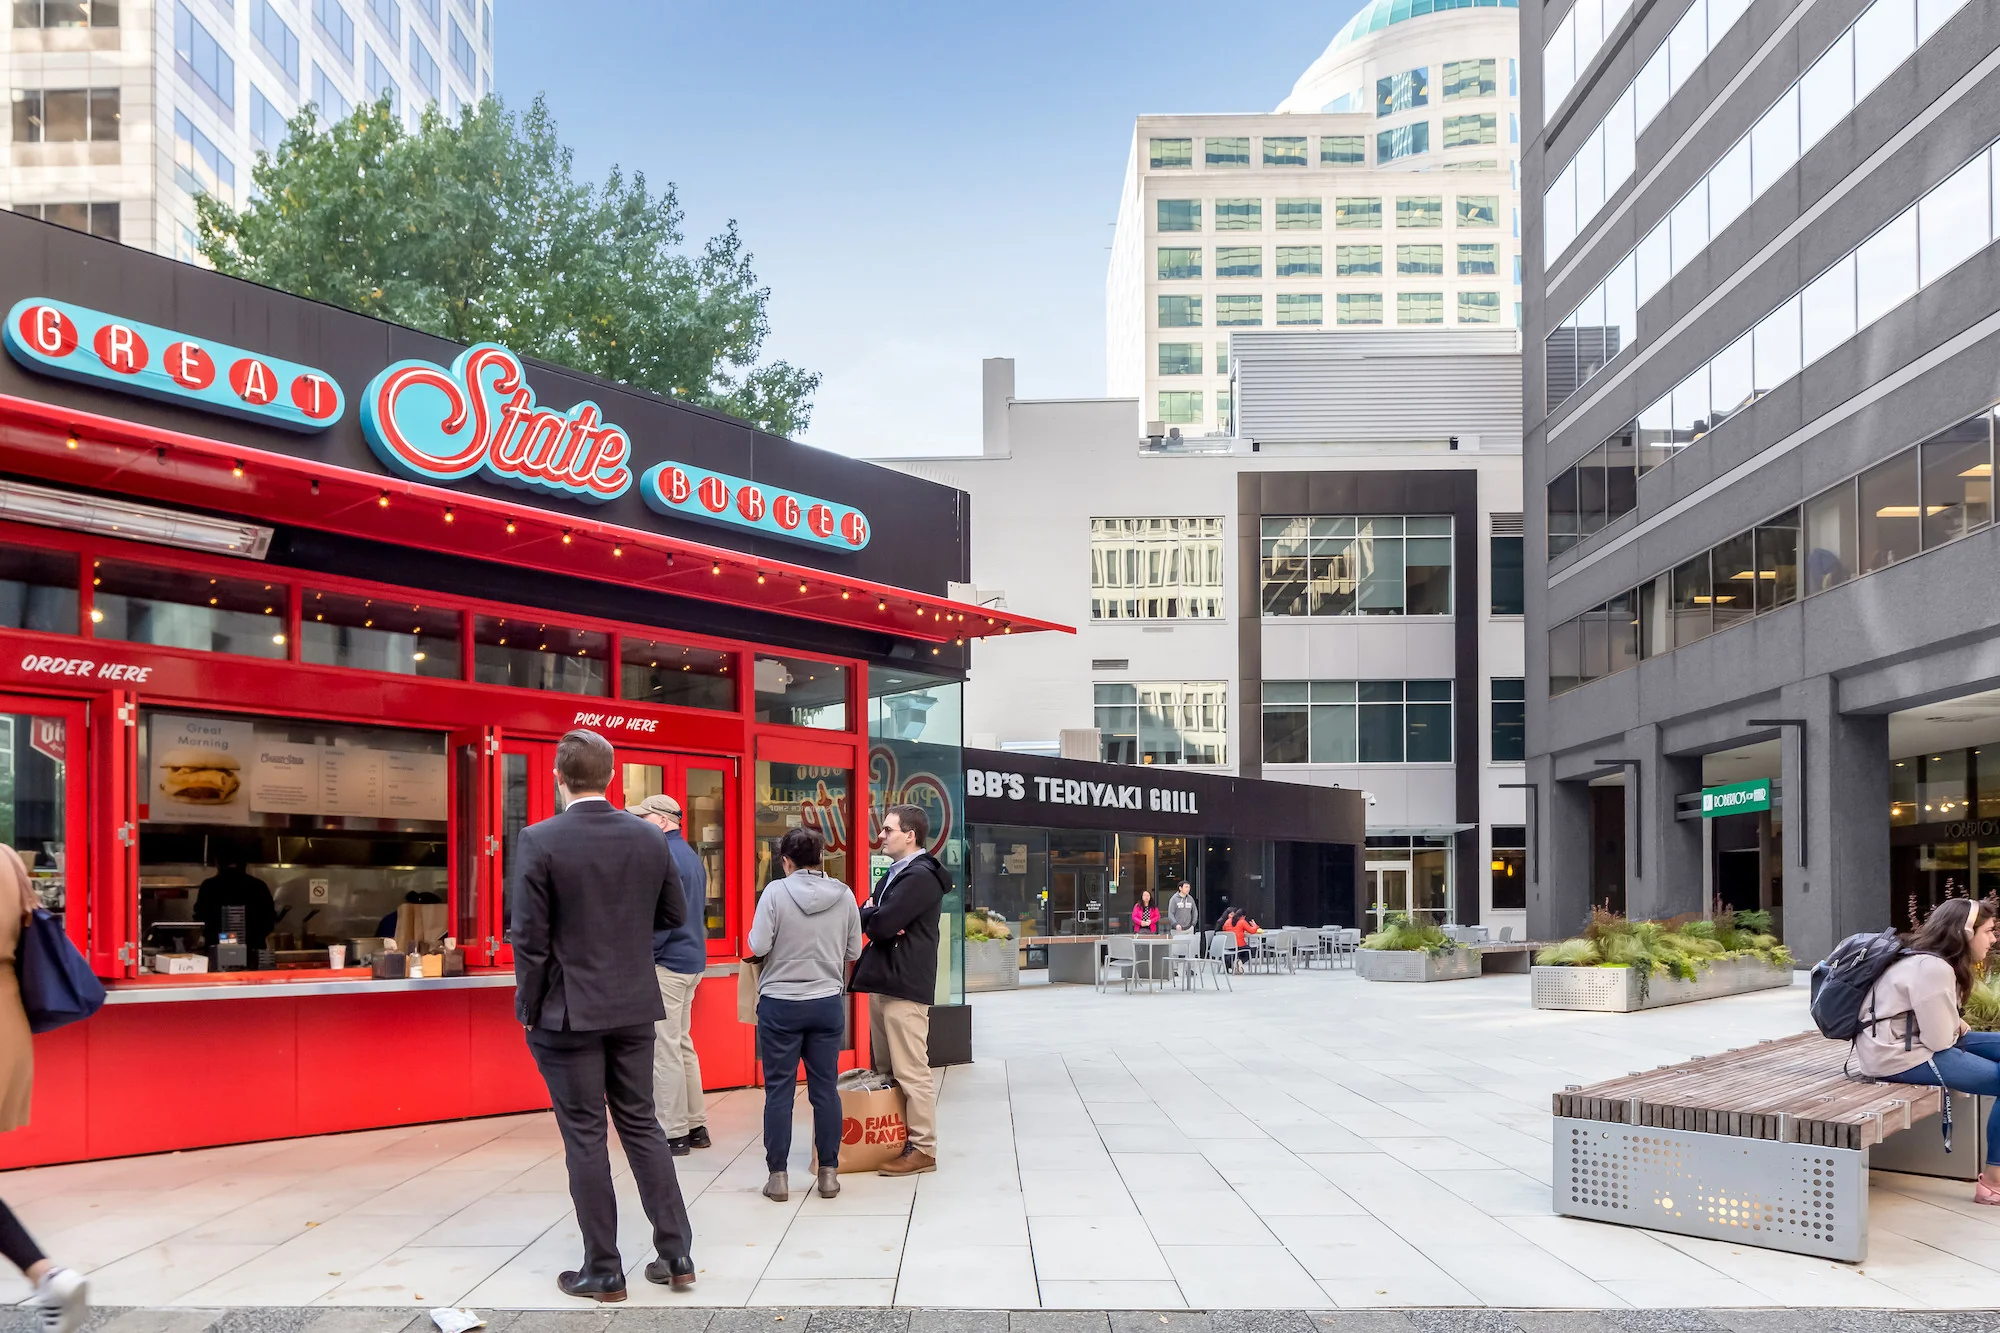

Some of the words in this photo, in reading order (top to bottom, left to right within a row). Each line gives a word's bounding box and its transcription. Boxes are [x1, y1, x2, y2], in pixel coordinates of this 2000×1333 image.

[36, 306, 327, 414] GREAT
[378, 348, 629, 494] State
[671, 467, 865, 546] BURGER
[21, 654, 95, 677] ORDER
[97, 663, 153, 683] HERE
[186, 723, 222, 735] Great
[573, 711, 605, 727] PICK
[605, 715, 625, 729] UP
[626, 718, 660, 732] HERE
[177, 736, 229, 751] Morning
[967, 769, 1025, 800] BB'S
[1034, 776, 1142, 810] TERIYAKI
[1150, 788, 1199, 814] GRILL
